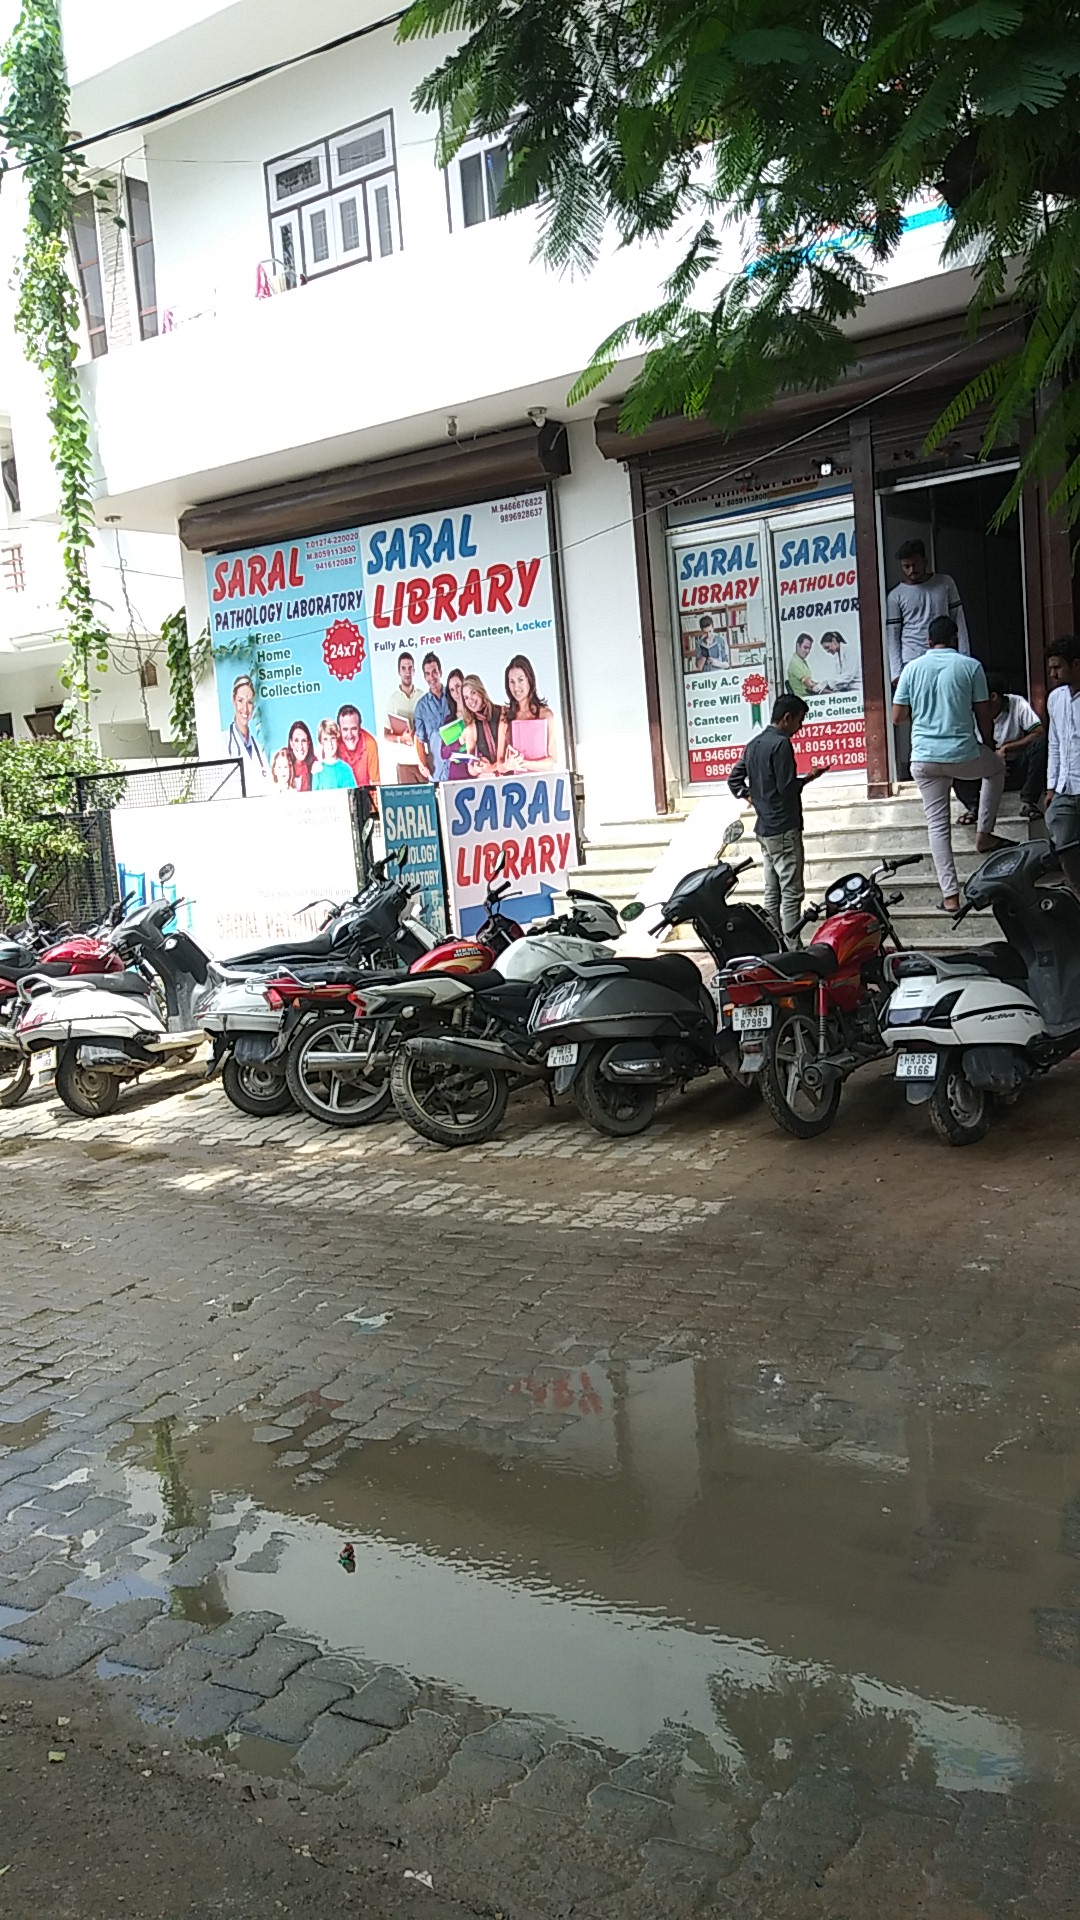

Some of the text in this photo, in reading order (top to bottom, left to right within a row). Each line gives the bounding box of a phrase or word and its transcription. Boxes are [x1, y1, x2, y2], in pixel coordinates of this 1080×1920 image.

[491, 497, 543, 514] M.9466676822
[500, 508, 543, 523] 9896928637
[367, 514, 477, 575] SARAL
[315, 557, 357, 571] 9416120887
[680, 542, 758, 581] SARAL
[213, 547, 304, 602] SARAL
[373, 558, 541, 629] LIBRARY
[681, 576, 760, 608] LIBRARY
[215, 590, 363, 631] PATHOLOGY LABORATORY
[255, 632, 281, 645] Free
[374, 639, 396, 652] Fully
[420, 634, 442, 646] Free
[516, 618, 553, 632] Locker
[257, 649, 291, 663] Home
[329, 641, 357, 659] 24x7
[258, 664, 303, 681] Sample
[260, 681, 321, 698] Collection
[691, 675, 740, 691] Fully A.C
[746, 683, 764, 694] 24x7
[692, 694, 741, 709] Free Wifi
[828, 695, 858, 705] Home
[693, 714, 740, 727] Canteen
[695, 732, 733, 745] Locker
[451, 779, 571, 836] SARAL
[385, 804, 437, 842] SARAL
[456, 832, 571, 887] LIBRARY
[741, 1007, 764, 1018] HR36
[740, 1016, 768, 1029] R7989
[904, 1054, 933, 1065] HR36S
[906, 1065, 930, 1075] 6166
